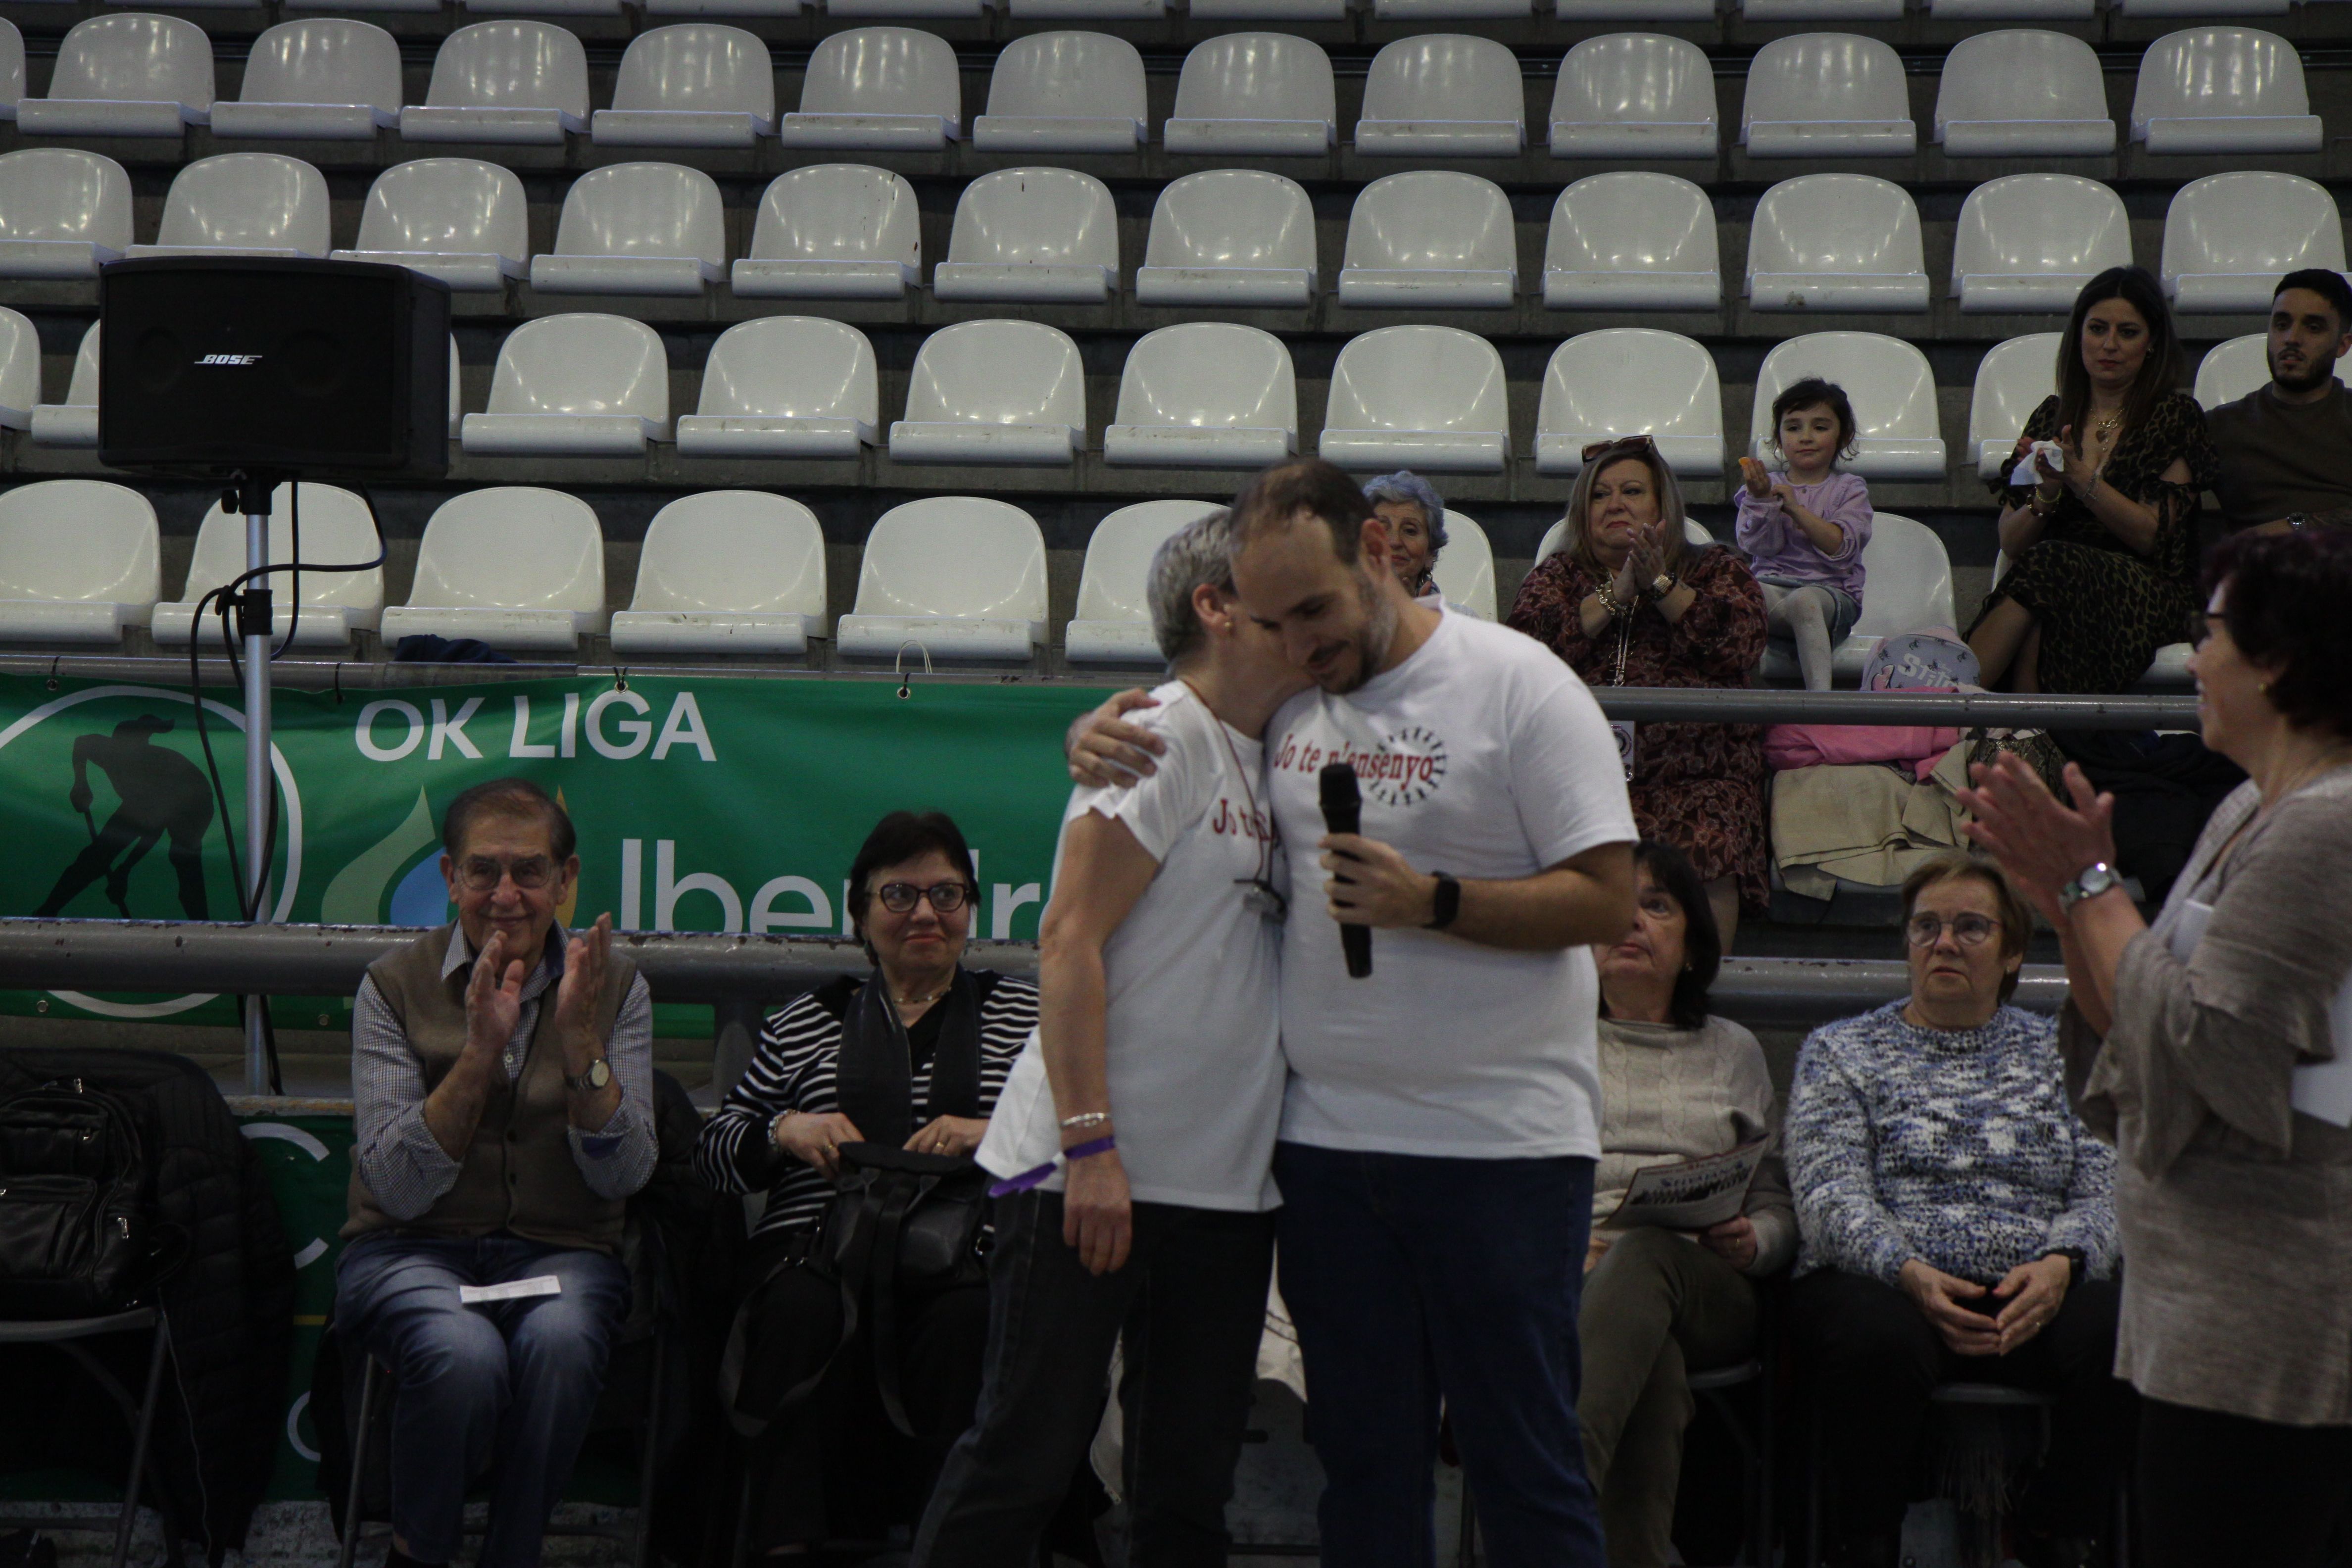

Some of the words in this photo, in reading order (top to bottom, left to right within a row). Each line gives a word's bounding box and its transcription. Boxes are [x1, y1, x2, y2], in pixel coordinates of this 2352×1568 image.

[194, 354, 263, 365] BOSE
[354, 697, 487, 762] OK
[509, 690, 717, 762] LIGA
[1274, 734, 1297, 771] Jo
[1298, 742, 1321, 773] te
